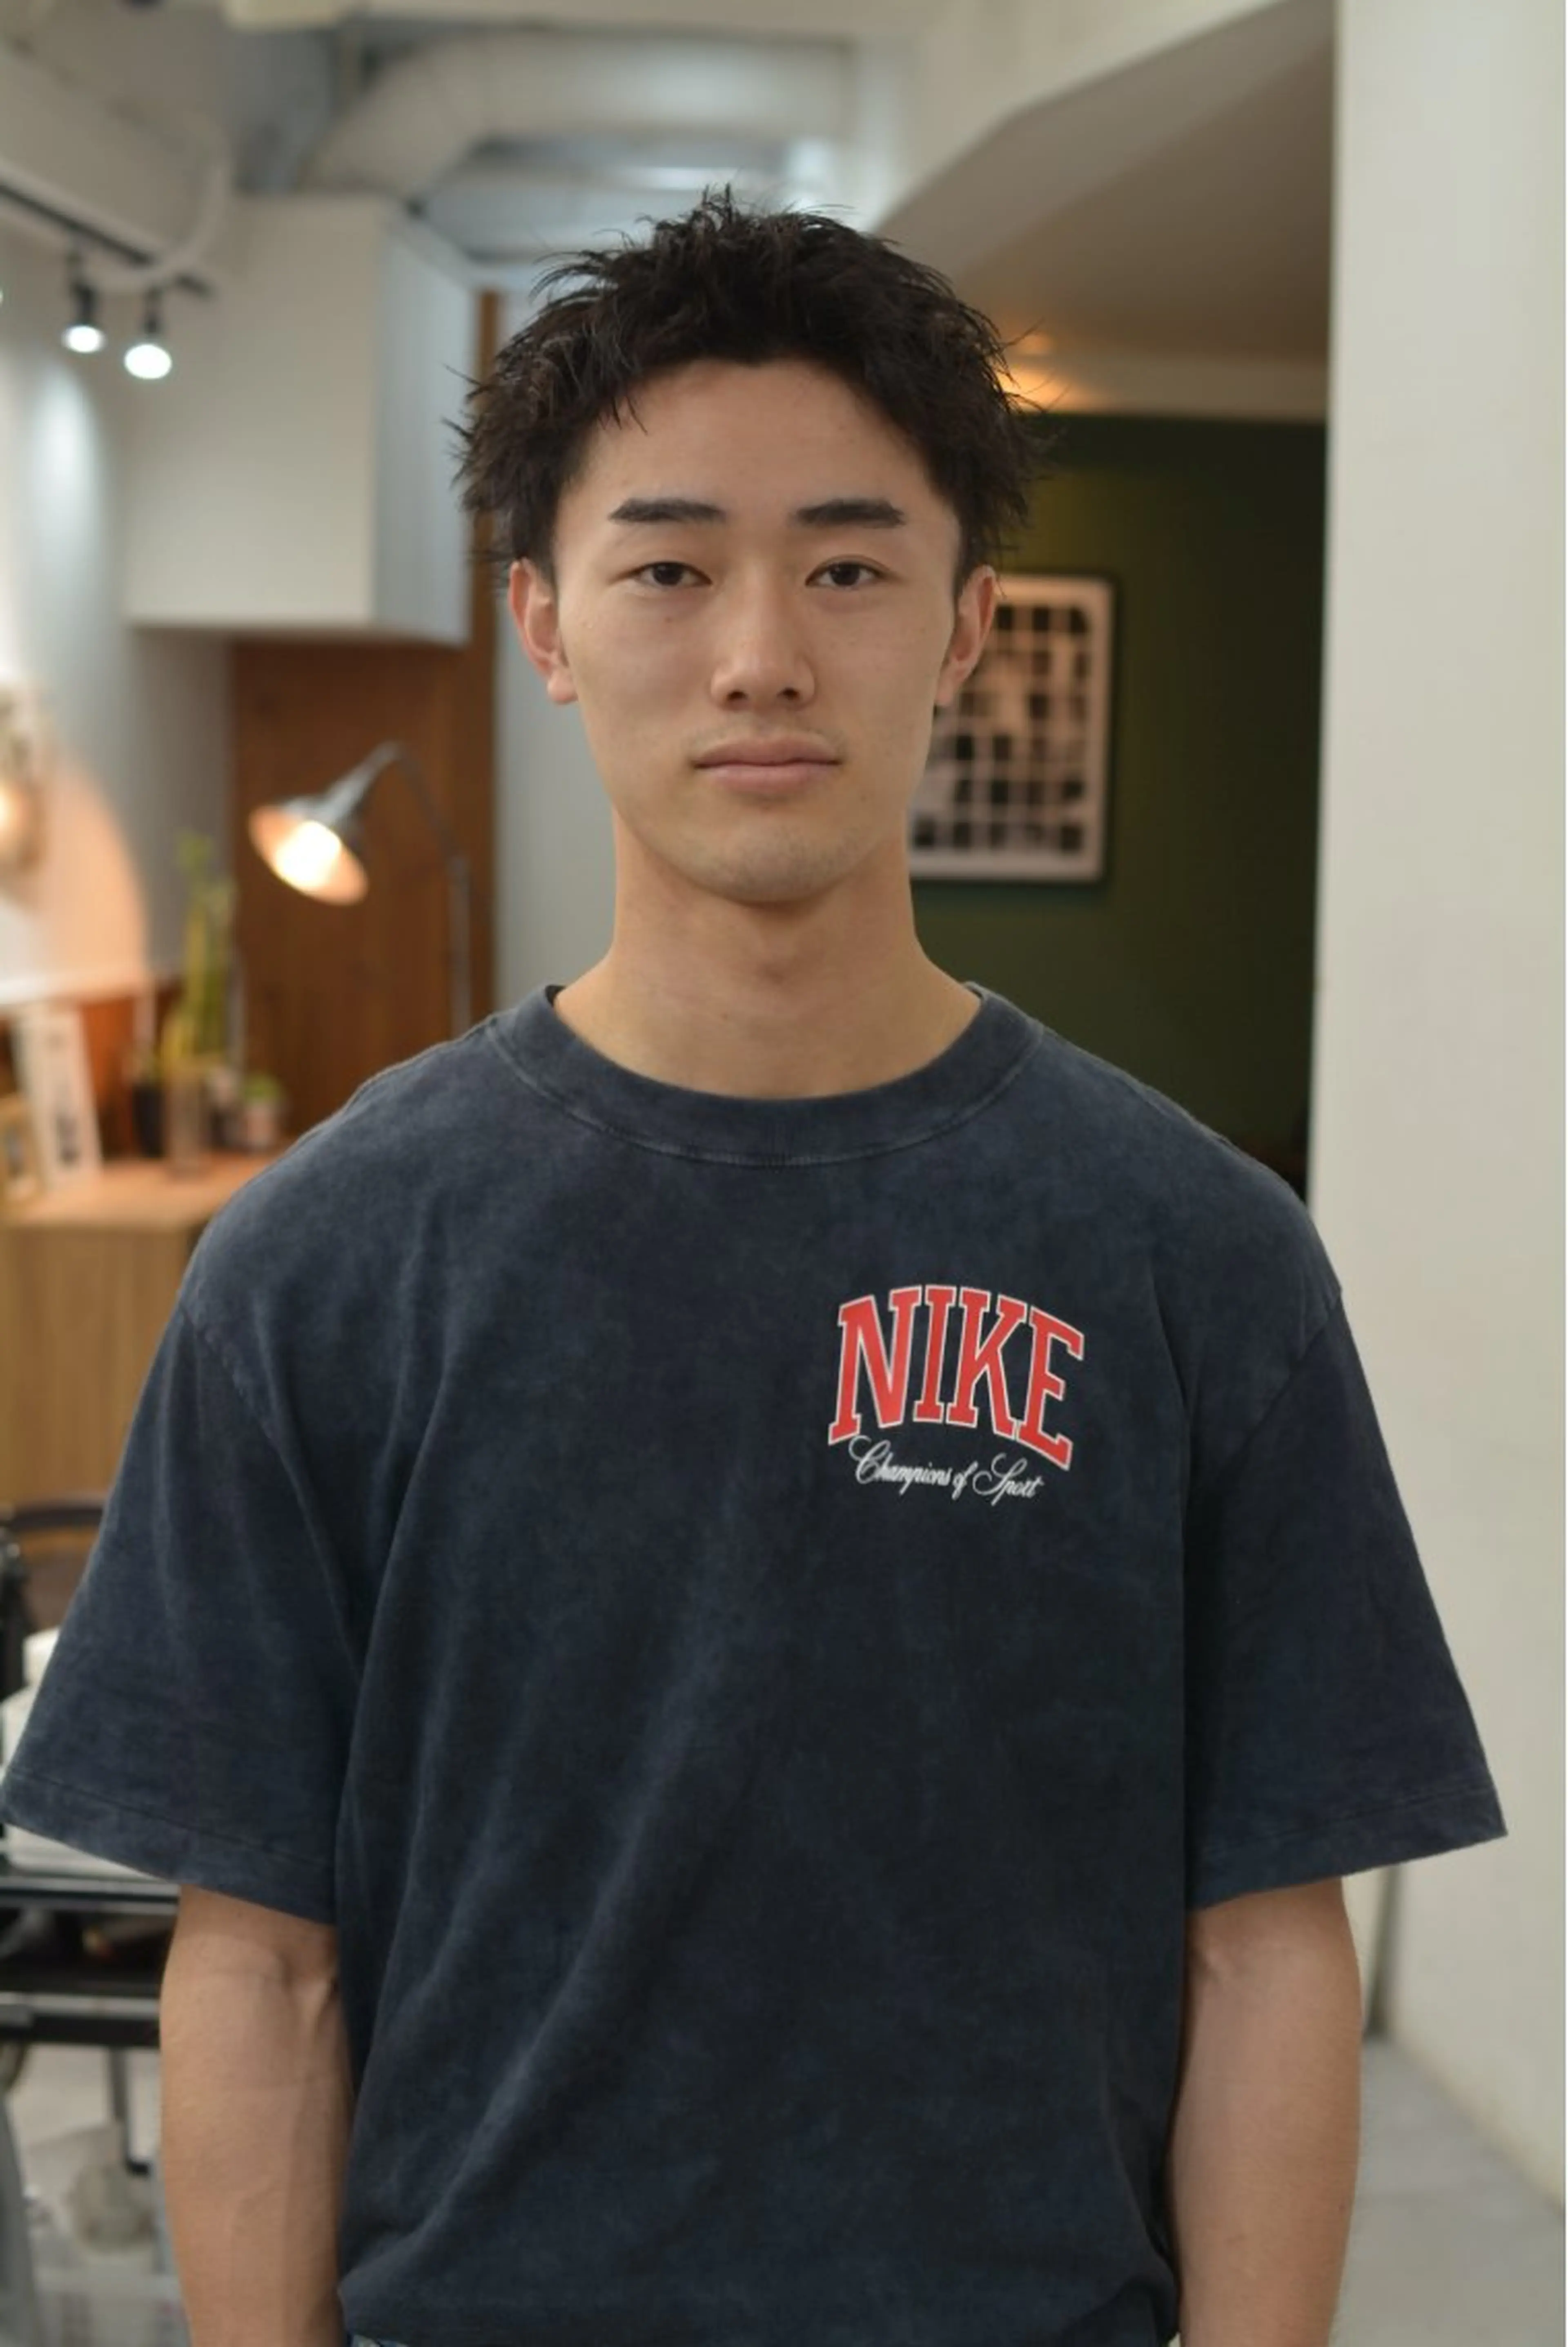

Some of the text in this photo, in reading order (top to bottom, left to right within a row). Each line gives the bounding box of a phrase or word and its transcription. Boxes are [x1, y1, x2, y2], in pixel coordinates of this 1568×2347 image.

[828, 1284, 1085, 1471] NIKE
[849, 1435, 1044, 1506] Champions of Sport
